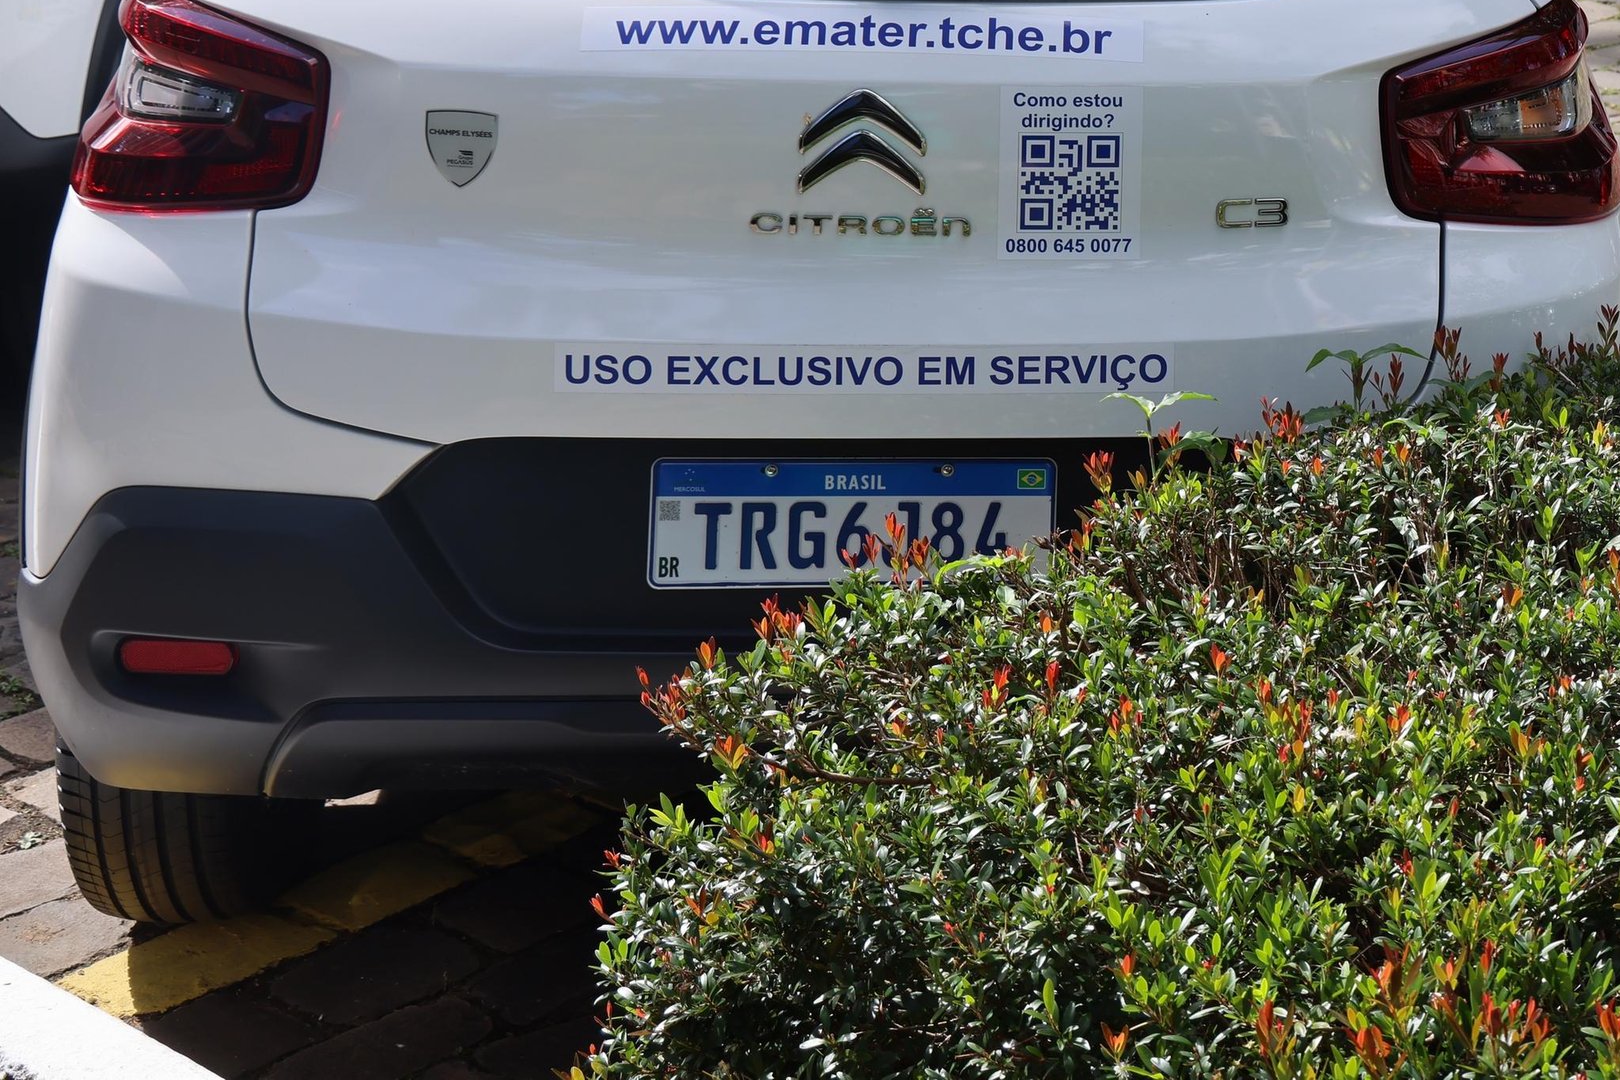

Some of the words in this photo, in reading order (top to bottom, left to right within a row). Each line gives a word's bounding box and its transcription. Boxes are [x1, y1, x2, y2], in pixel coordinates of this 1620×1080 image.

[616, 15, 1112, 54] www.emater.tche.br
[1013, 92, 1067, 107] Como
[1073, 94, 1123, 107] estou
[429, 128, 460, 136] CHAMPS
[1021, 114, 1114, 131] dirigindo?
[1216, 198, 1288, 229] C3
[1005, 238, 1047, 253] 0800
[1053, 238, 1085, 253] 645
[1090, 238, 1132, 253] 0077
[564, 354, 652, 385] USO
[666, 355, 905, 386] EXCLUSIVO
[918, 355, 977, 385] EM
[988, 353, 1168, 391] SERVIÇO
[824, 474, 886, 490] BRASIL
[694, 501, 1007, 570] TRG6J84
[658, 556, 679, 578] BR
